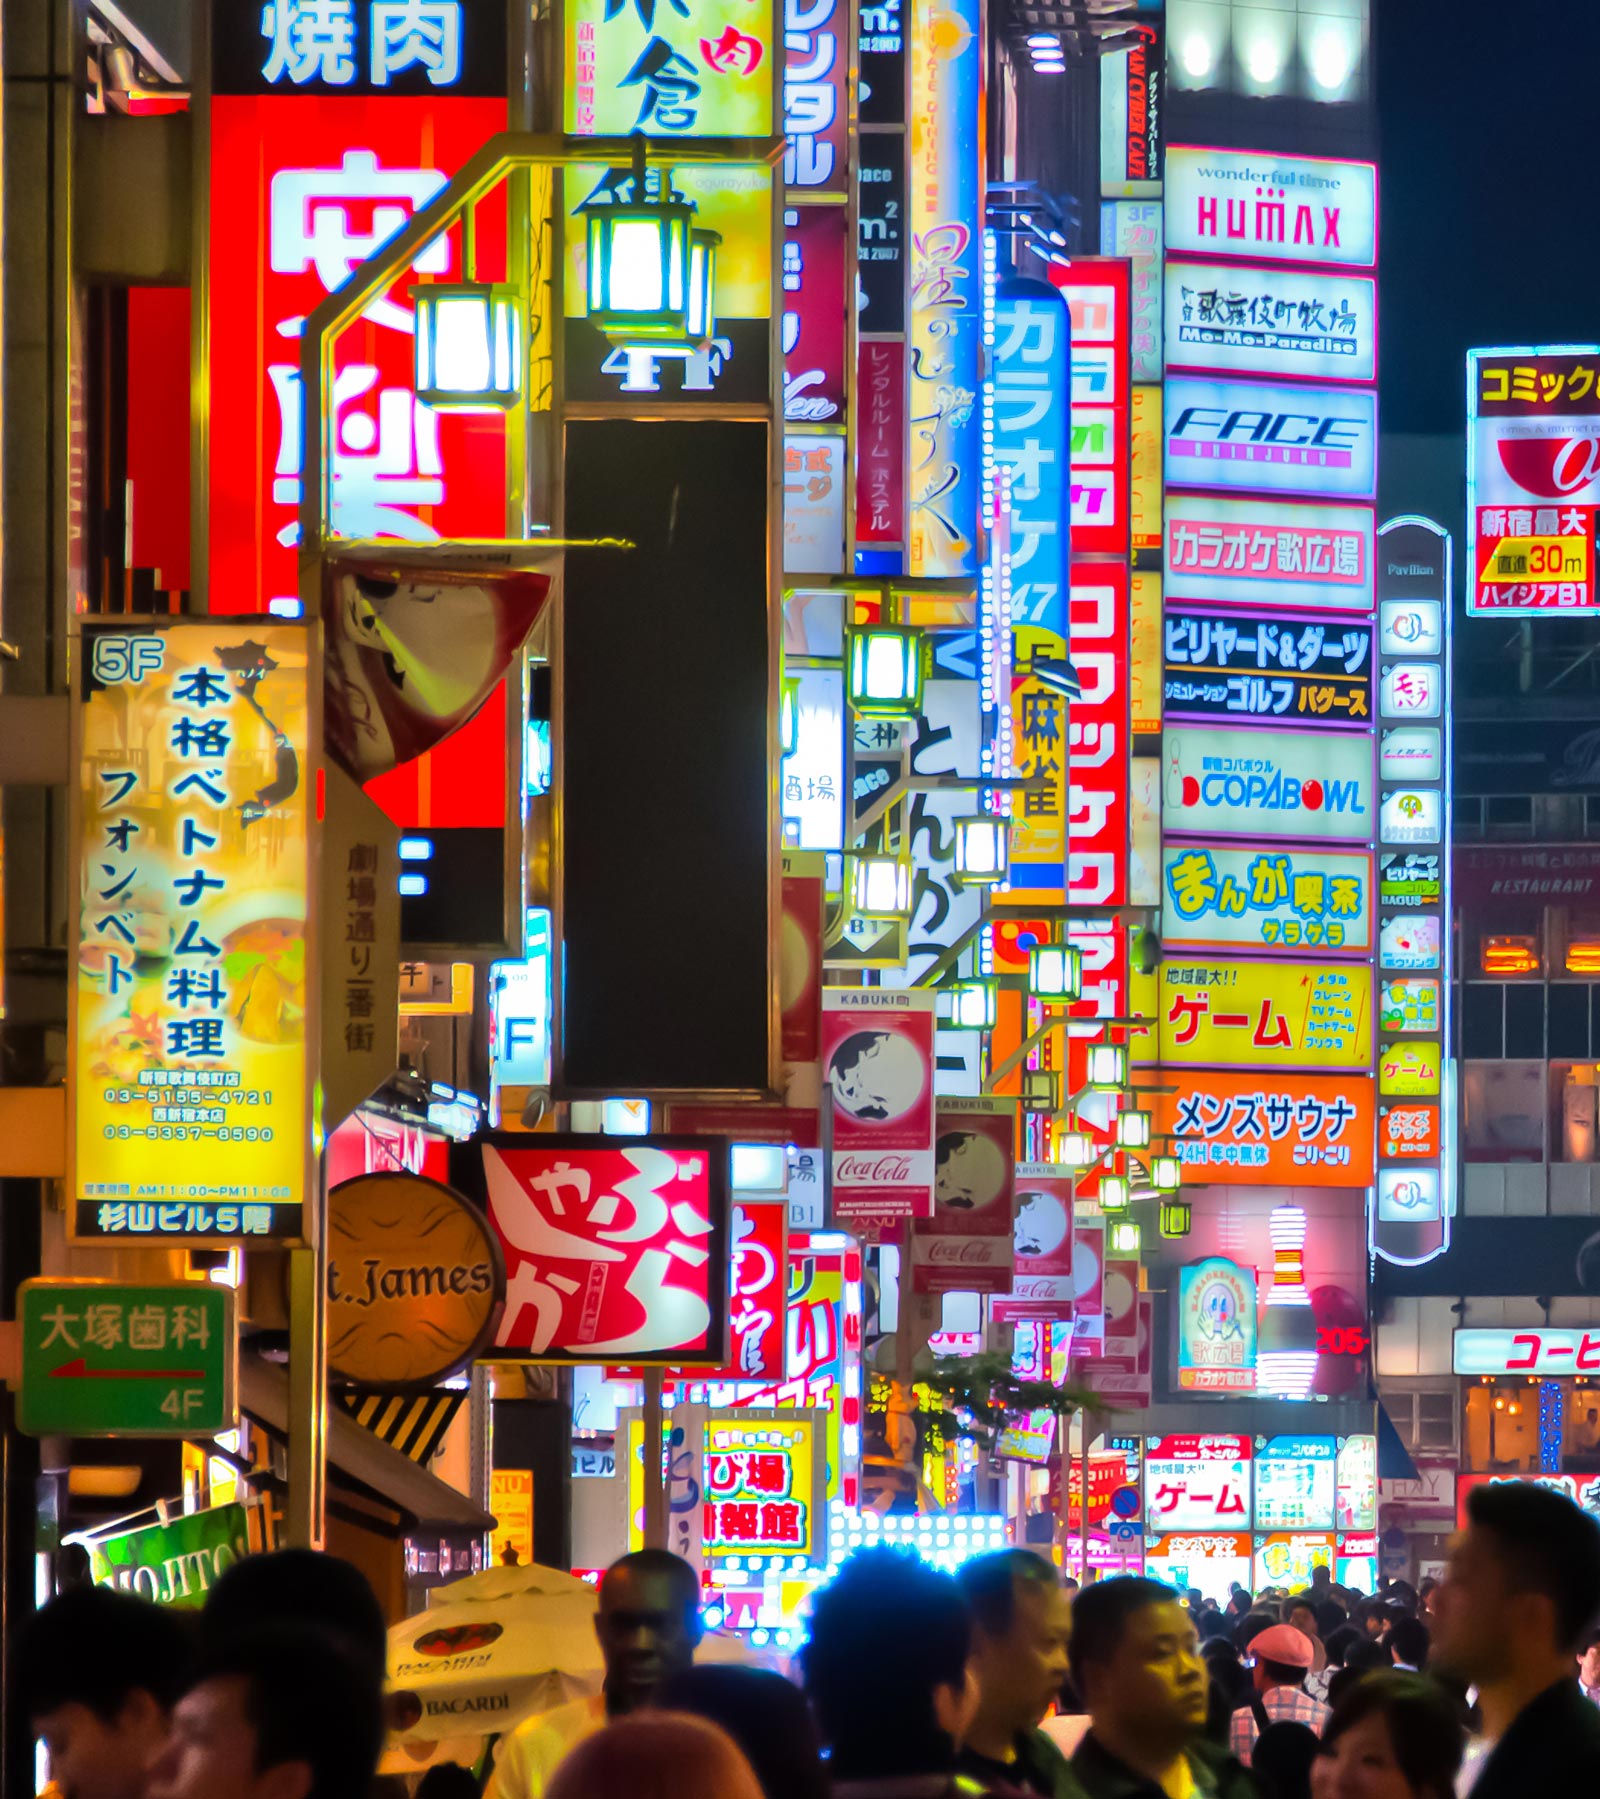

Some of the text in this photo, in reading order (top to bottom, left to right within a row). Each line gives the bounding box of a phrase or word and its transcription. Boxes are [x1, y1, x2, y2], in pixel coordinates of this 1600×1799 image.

[261, 0, 460, 86] 焼肉
[577, 21, 596, 135] 新宿歌舞伎
[1197, 165, 1298, 185] wonderful
[1127, 206, 1156, 222] 3F
[1197, 187, 1342, 248] HUMAX
[1199, 288, 1358, 335] 歌舞伎町牧場
[1181, 326, 1357, 354] Mo-Mo-Paradise
[995, 300, 1058, 570] カラオケ
[1170, 407, 1369, 449] FACE
[1194, 443, 1328, 466] SHINJUKU
[1481, 507, 1587, 537] 新宿最大
[1172, 524, 1361, 577] カラオケ歌広場
[1480, 582, 1587, 607] ハイジアB1
[92, 635, 165, 685] 5F
[1165, 616, 1370, 674] ビリヤード&ダーツ
[1297, 685, 1369, 717] バグース
[1202, 756, 1274, 774] 新宿コパボウル
[1201, 769, 1366, 814] COPABOWL
[171, 666, 233, 1058] 本格ベトナム料理
[1386, 867, 1439, 881] ビリヤード
[94, 771, 140, 994] フォンベト
[1168, 851, 1361, 918] まんが喫茶
[345, 844, 379, 1053] 劇場通り一番街
[1165, 966, 1238, 987] 地域最大!!
[1169, 991, 1294, 1049] ゲーム
[138, 1070, 240, 1087] 新宿歌舞伎町店
[1383, 1062, 1436, 1080] ゲーム
[103, 1089, 273, 1105] 03-5155-4721
[152, 1107, 226, 1124] 西新宿本店
[1175, 1093, 1356, 1141] メンズサウナ
[103, 1125, 274, 1142] 03-5337-8590
[1388, 1126, 1431, 1140] サウナ
[836, 1154, 914, 1182] Coca-Cola
[97, 1202, 273, 1236] 杉山ビル5階
[327, 1258, 492, 1308] t.James
[39, 1304, 211, 1351] 大塚歯科
[159, 1387, 205, 1421] 4F
[1155, 1481, 1247, 1516] ゲーム
[426, 1693, 510, 1717] BACARDI
